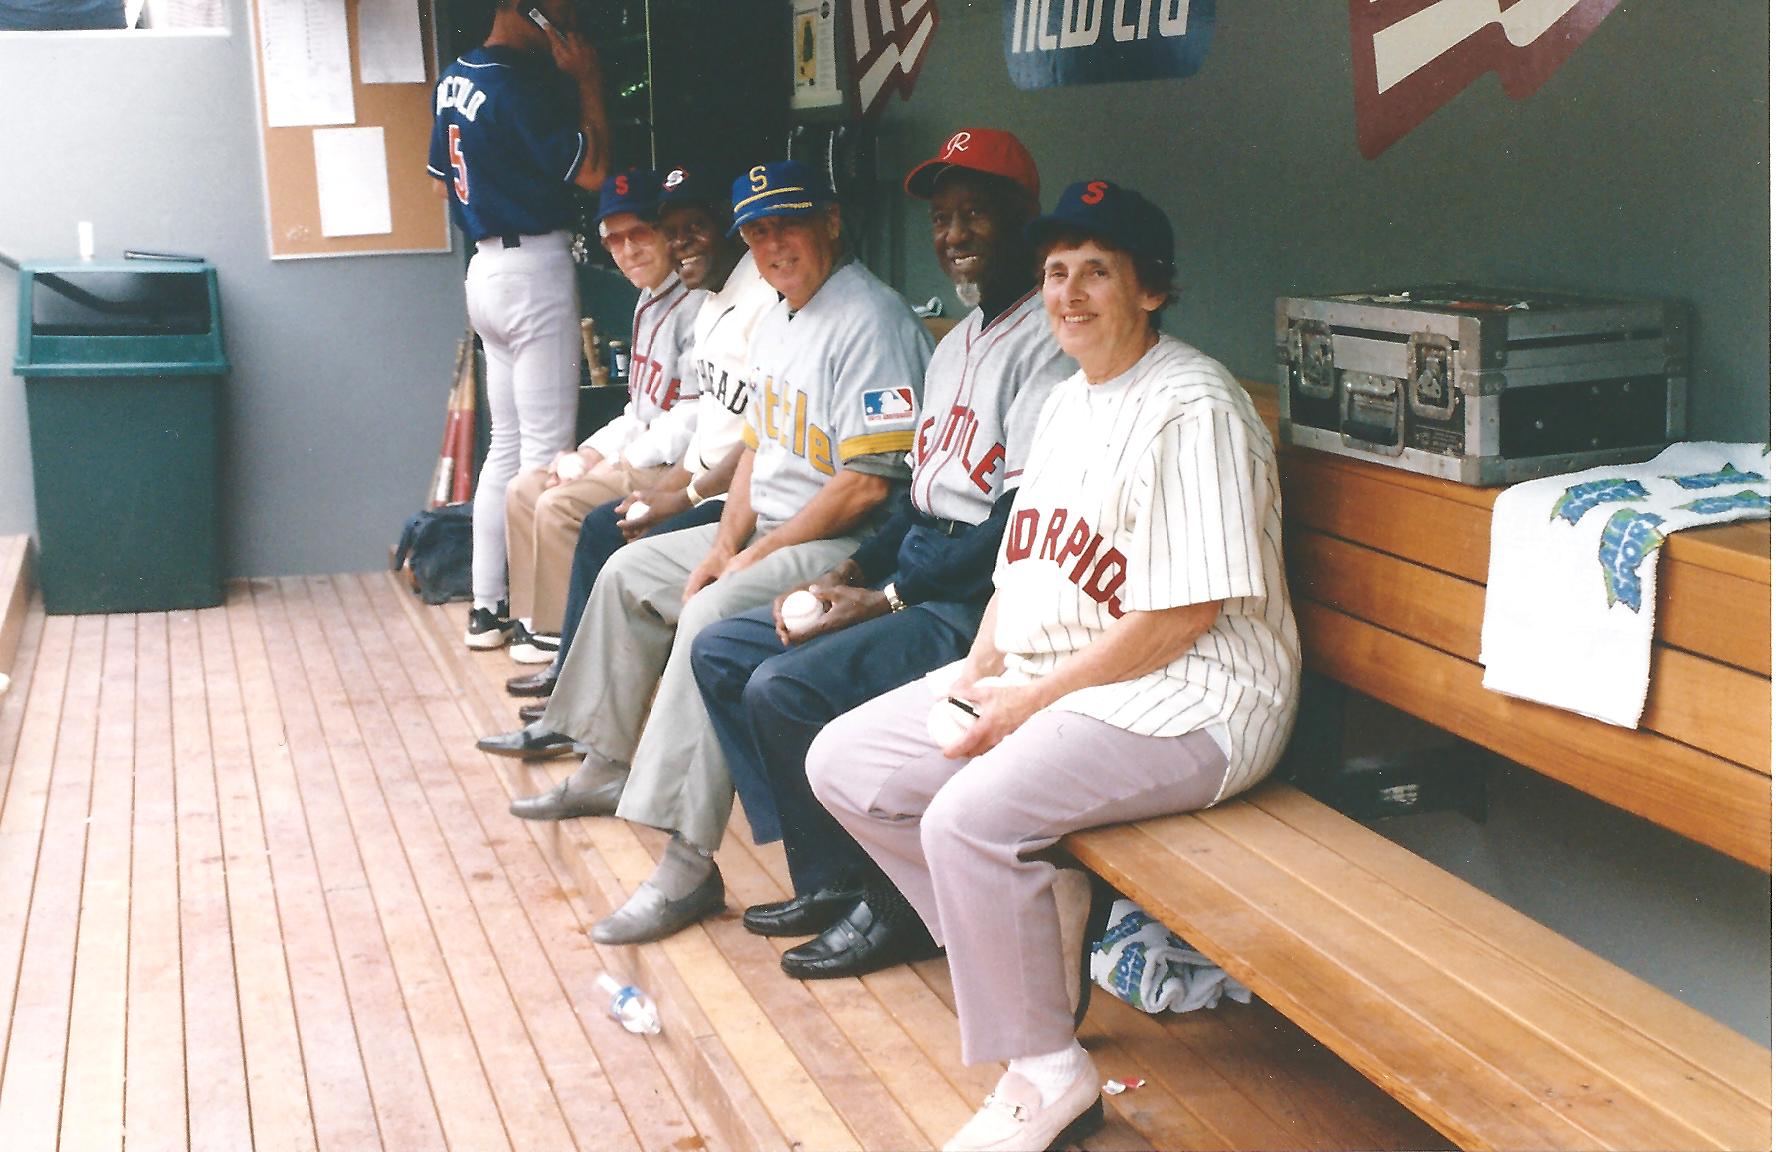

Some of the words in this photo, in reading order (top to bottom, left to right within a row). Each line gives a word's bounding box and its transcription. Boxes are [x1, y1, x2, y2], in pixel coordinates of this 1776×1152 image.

[943, 132, 971, 160] R
[448, 124, 469, 205] 5
[615, 175, 629, 196] S
[750, 165, 768, 192] S
[1081, 181, 1108, 205] S
